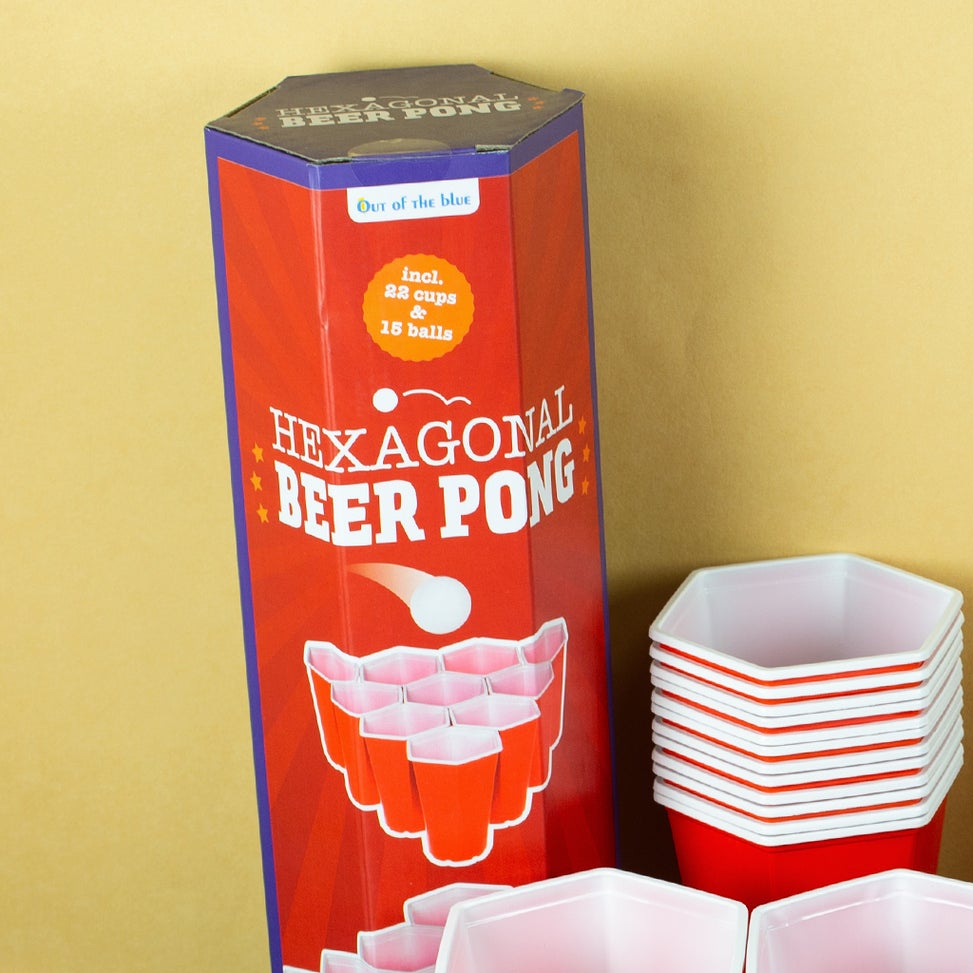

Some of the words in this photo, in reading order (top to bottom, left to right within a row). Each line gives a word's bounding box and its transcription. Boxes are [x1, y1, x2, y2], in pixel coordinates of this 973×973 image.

[275, 93, 519, 117] HEXAGONAL
[278, 110, 395, 128] BEER
[403, 101, 522, 120] PONG
[392, 196, 407, 211] of
[401, 266, 444, 285] incl.
[384, 283, 410, 300] 22
[413, 289, 457, 306] cups
[410, 305, 427, 320] &
[380, 320, 403, 336] 15
[407, 322, 453, 341] balls
[269, 385, 574, 473] HEXAGONAL
[274, 460, 426, 547] BEER
[438, 438, 575, 540] PONG
